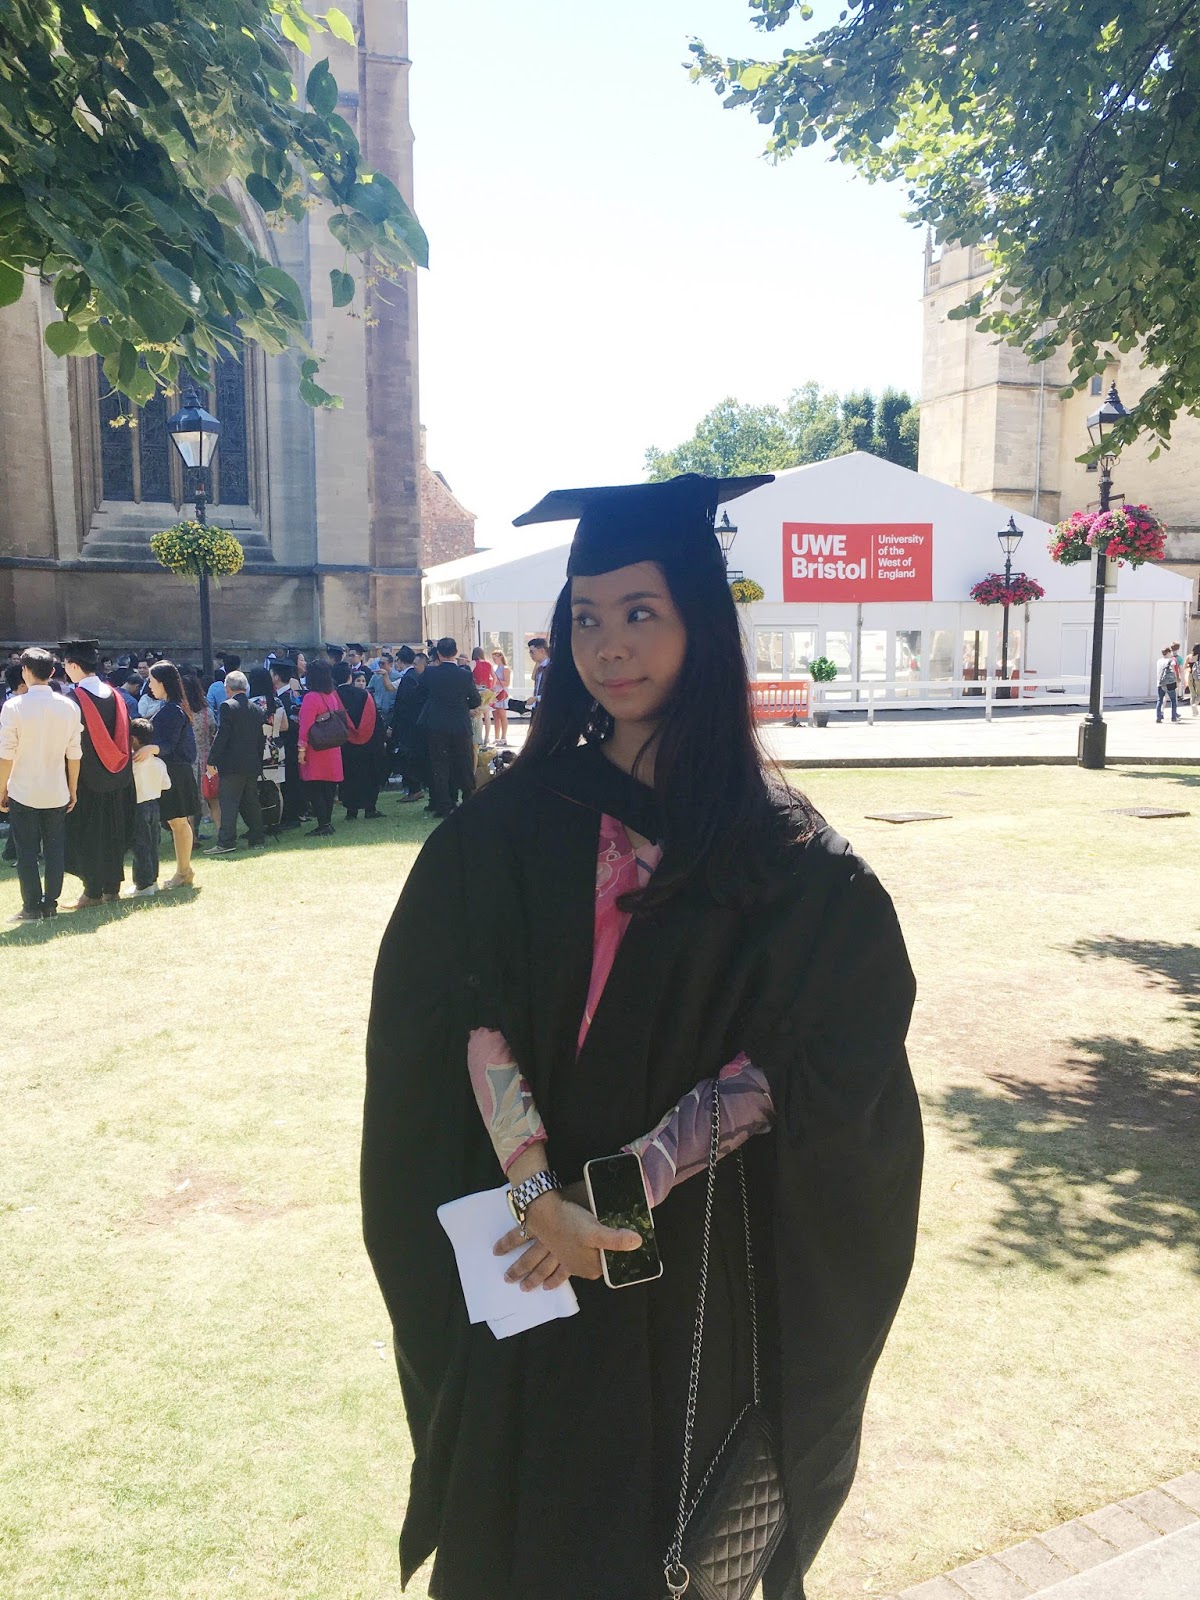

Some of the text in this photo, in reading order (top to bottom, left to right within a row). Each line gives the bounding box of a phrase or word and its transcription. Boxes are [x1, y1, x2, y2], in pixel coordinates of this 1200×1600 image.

[791, 533, 847, 556] UWE
[878, 534, 925, 545] University
[878, 546, 905, 556] of the
[878, 557, 912, 567] West of
[791, 557, 867, 580] Bristol
[878, 569, 916, 580] England
